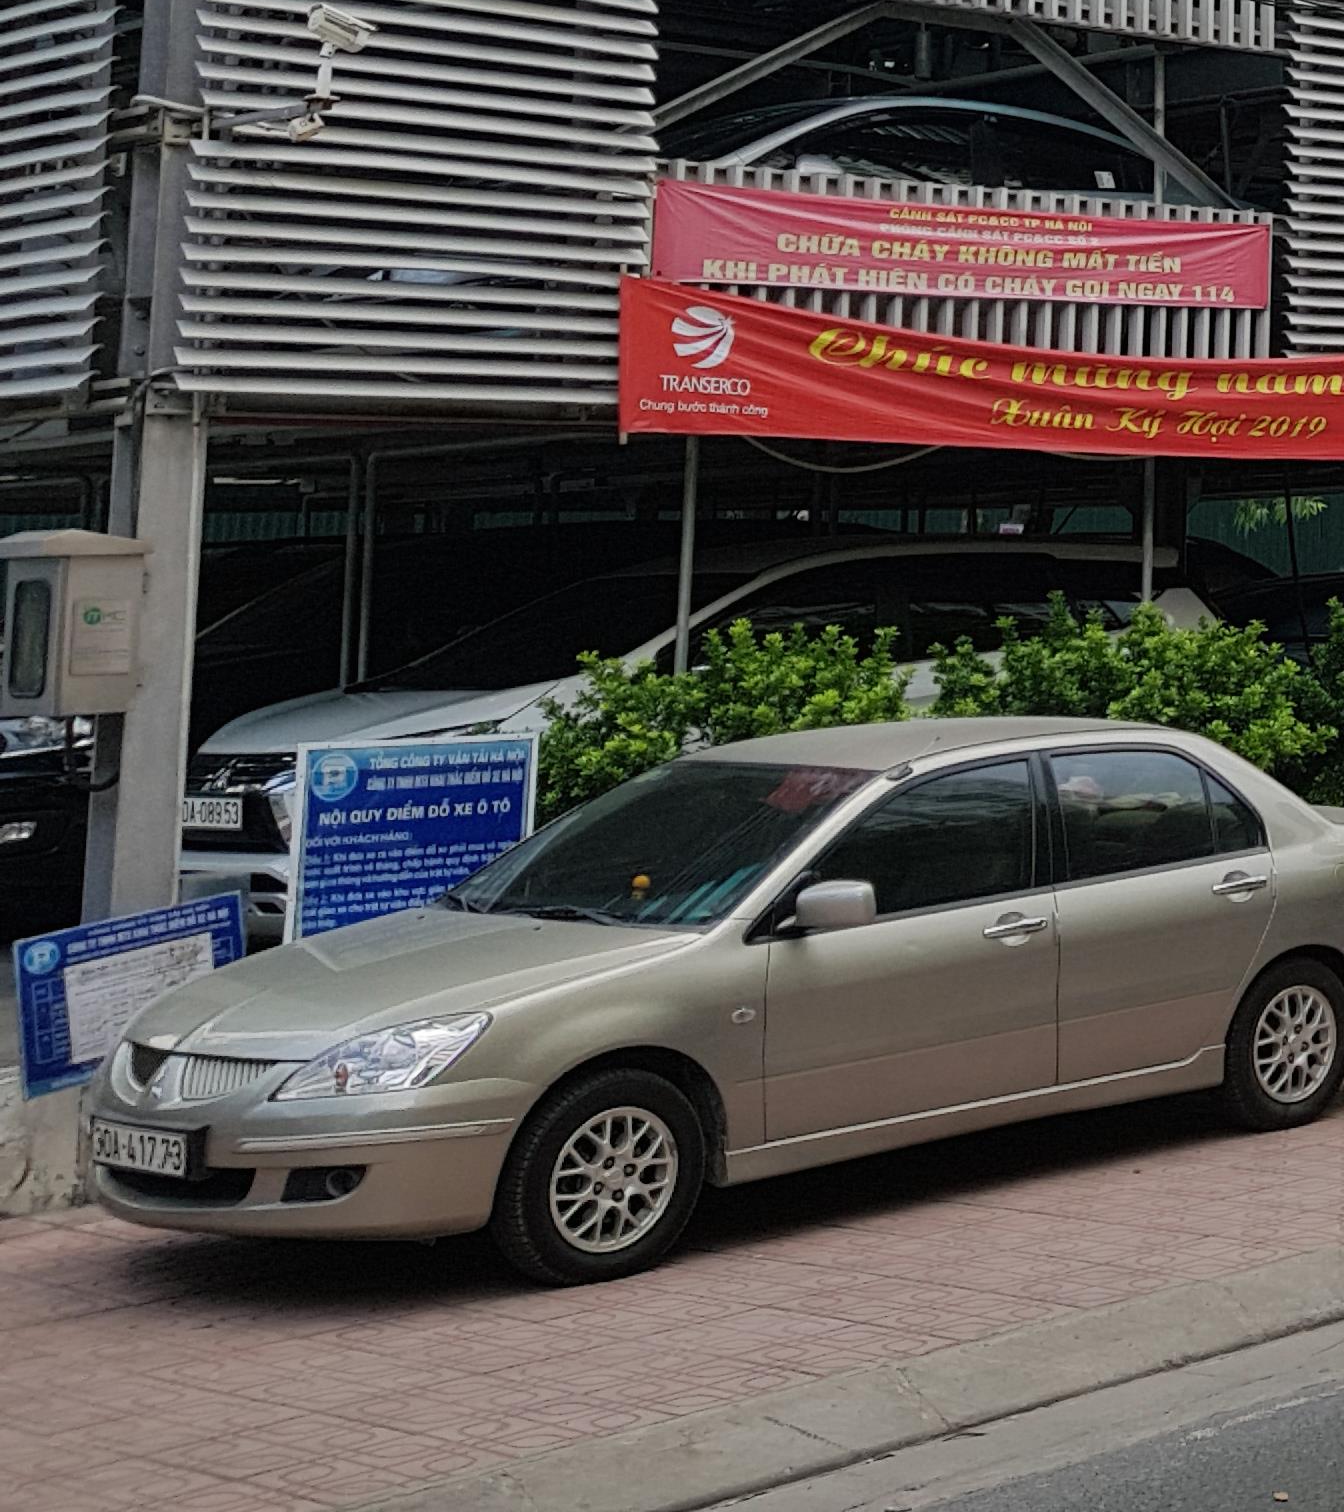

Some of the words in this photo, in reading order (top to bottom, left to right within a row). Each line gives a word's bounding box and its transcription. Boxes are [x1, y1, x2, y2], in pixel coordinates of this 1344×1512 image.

[1024, 218, 1041, 228] TP
[777, 233, 861, 257] CHỮA
[872, 240, 949, 263] CHÁY
[958, 245, 1054, 268] KHÔNG
[1062, 248, 1119, 271] MẤT
[1126, 251, 1182, 273] TIỀN
[703, 258, 757, 281] KHI
[768, 262, 848, 285] PHÁT
[938, 271, 975, 293] CÓ
[984, 273, 1057, 297] CHÁY
[1065, 279, 1109, 301] GỌI
[1118, 282, 1183, 300] NGAY
[1191, 285, 1235, 303] 114
[808, 327, 992, 380] Chúc
[659, 374, 751, 396] TRANSERCO
[640, 399, 675, 414] Chung
[742, 403, 769, 418] công
[990, 398, 1097, 429] Xuân
[1248, 415, 1327, 439] 2019
[182, 800, 239, 825] 0A-08953
[319, 808, 346, 829] NỘI
[351, 808, 382, 824] QUY
[454, 802, 472, 816] XE
[477, 798, 488, 813] Ô
[493, 797, 511, 813] TÔ
